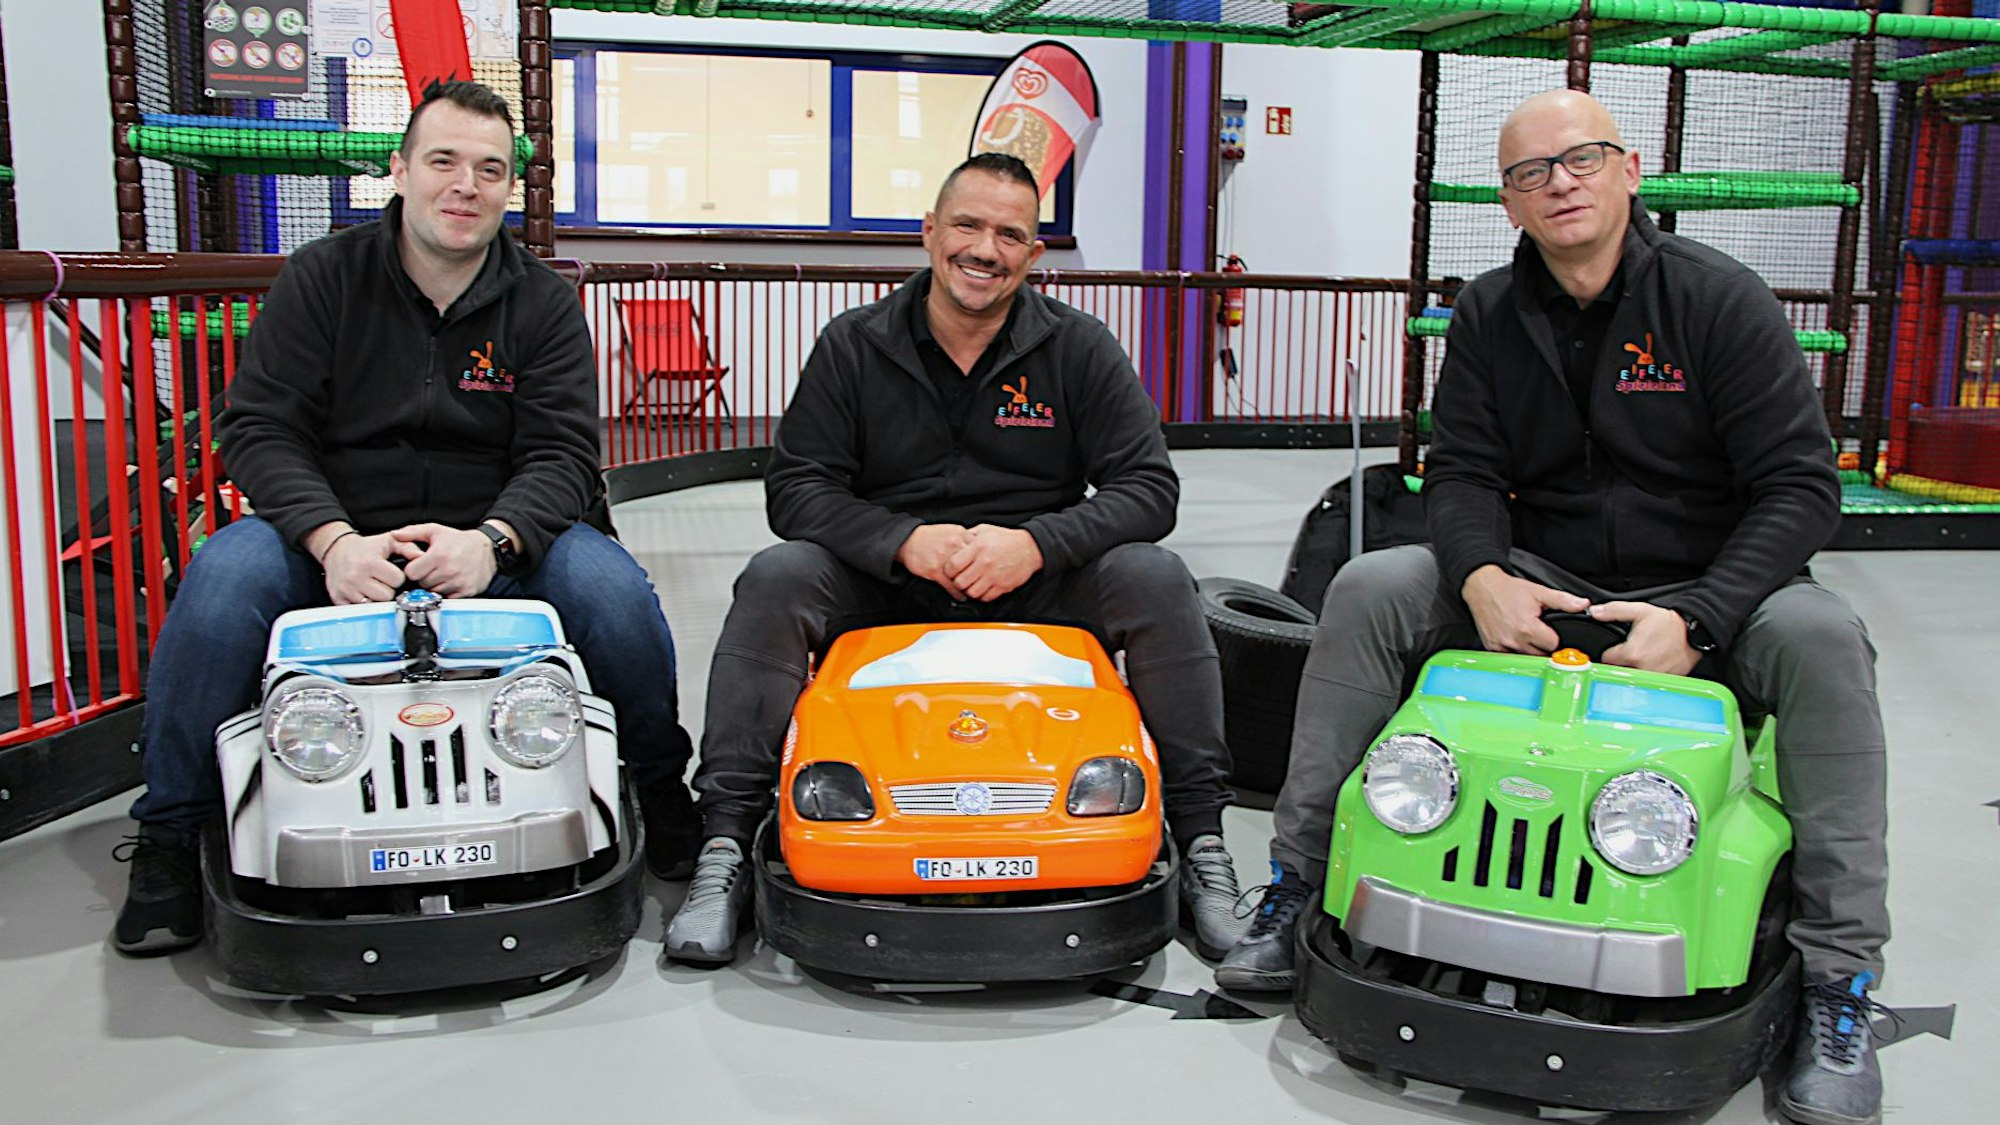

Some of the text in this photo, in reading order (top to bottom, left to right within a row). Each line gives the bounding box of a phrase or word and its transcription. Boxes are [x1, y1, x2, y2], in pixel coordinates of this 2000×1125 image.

[1620, 364, 1683, 380] EIFELER
[998, 402, 1053, 418] EIFELER
[388, 851, 409, 868] FO
[424, 848, 446, 866] LK
[454, 845, 491, 863] 230
[966, 861, 987, 876] LK
[996, 860, 1032, 876] 230
